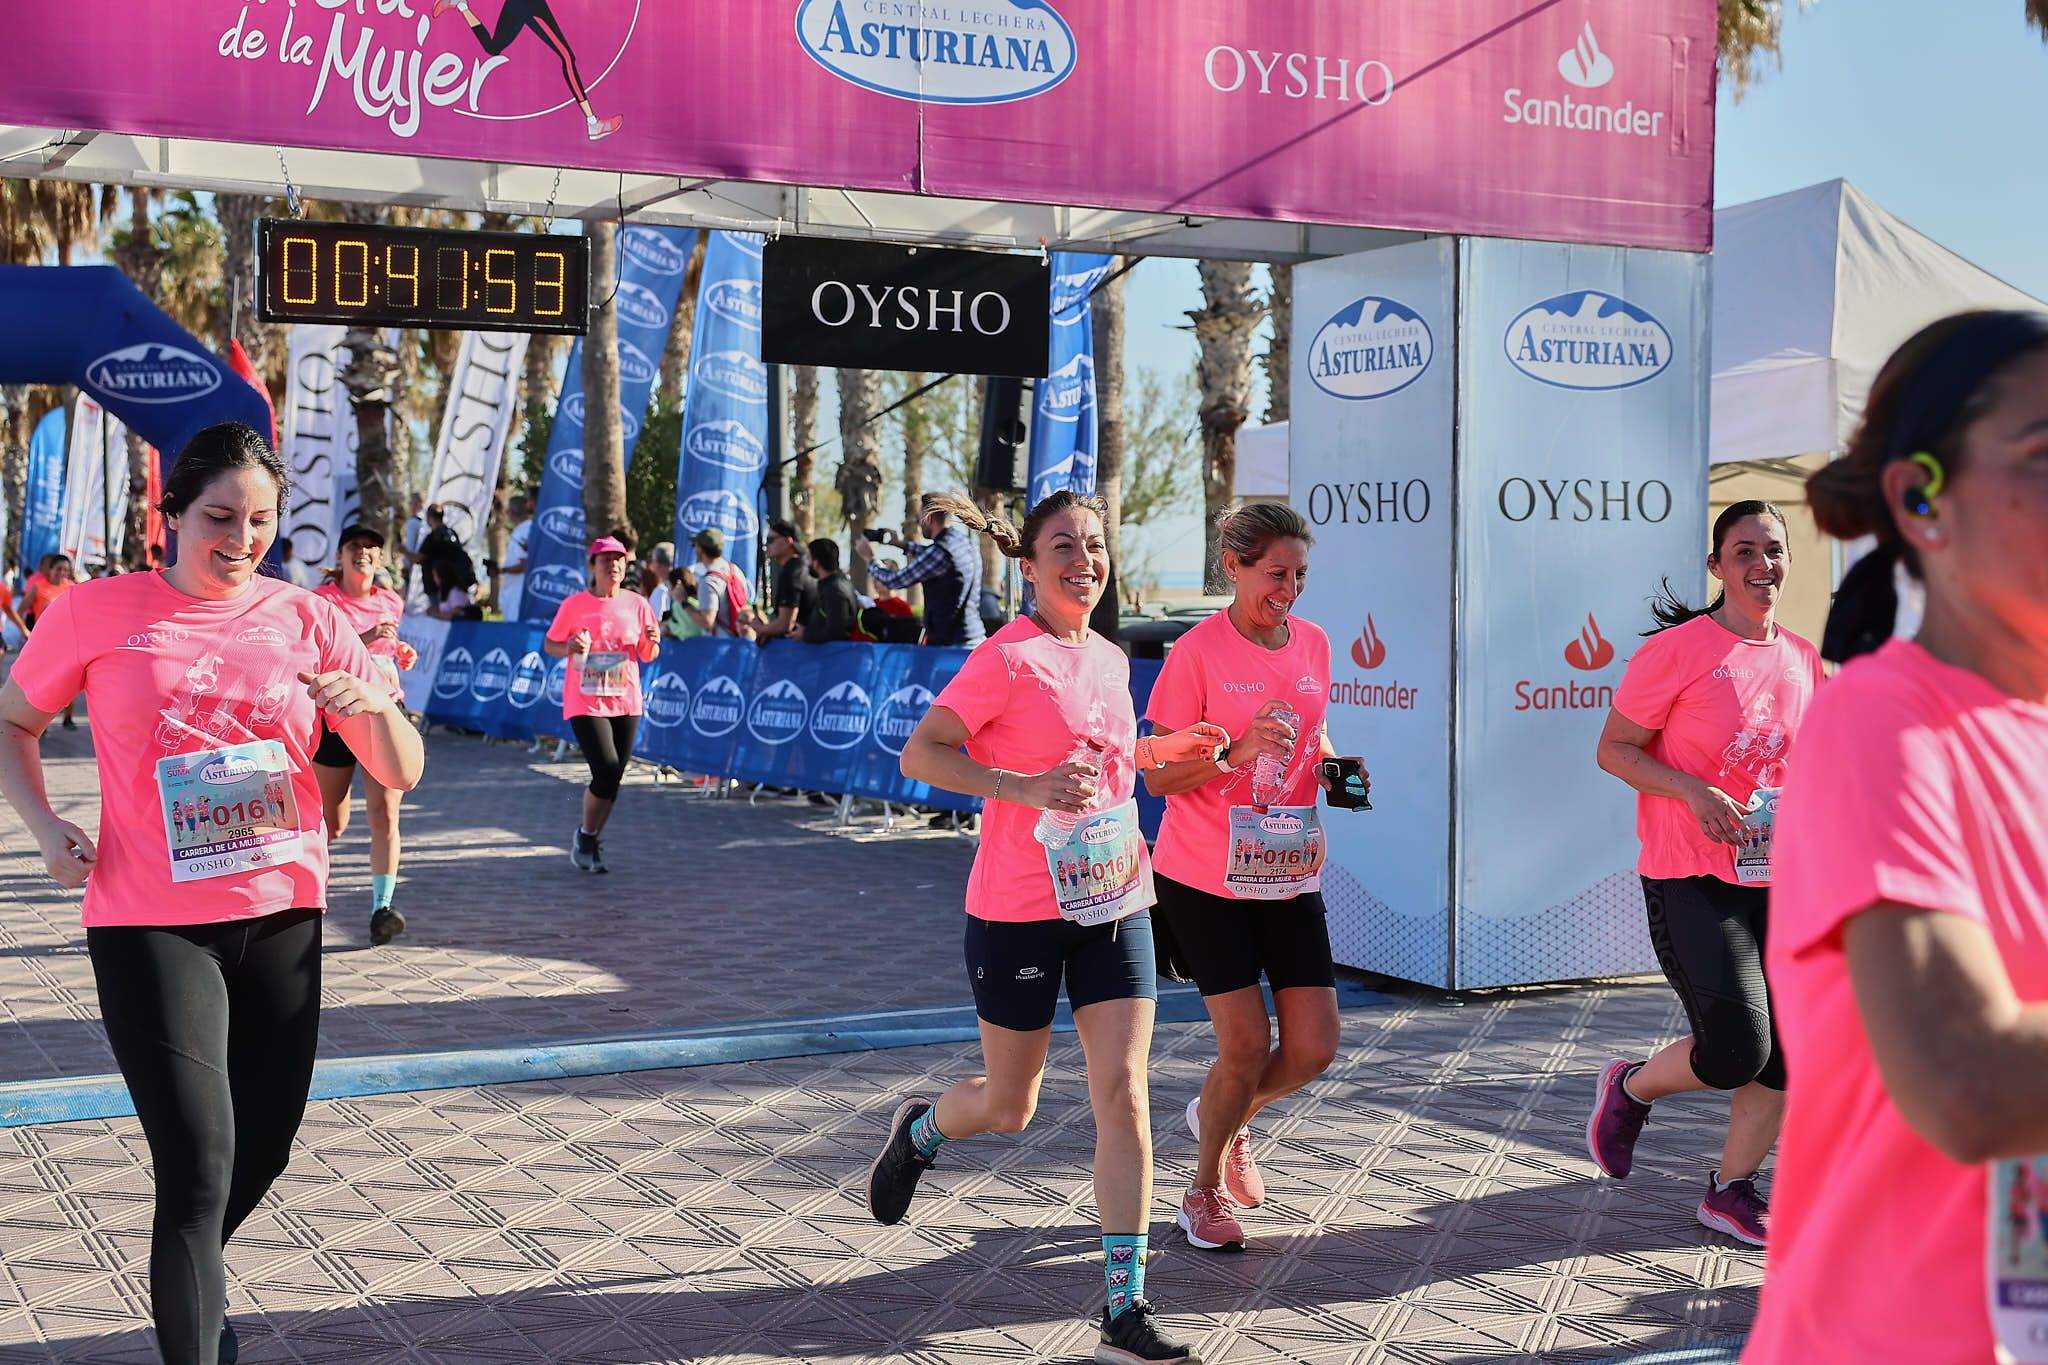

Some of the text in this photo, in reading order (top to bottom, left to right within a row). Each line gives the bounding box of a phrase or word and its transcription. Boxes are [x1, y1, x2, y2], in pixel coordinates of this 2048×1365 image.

[864, 0, 1047, 31] CENTRAL LECHERA
[819, 0, 1056, 74] ASTURIANA
[218, 5, 510, 138] de la Mujer
[1204, 45, 1394, 105] OYSHO
[1503, 87, 1664, 137] Santander
[283, 237, 565, 316] 00:41:53
[810, 279, 1012, 336] OYSHO
[1316, 341, 1423, 378] ASTURIANA
[1516, 324, 1660, 367] ASTURIANA
[98, 365, 214, 390] ASTURIANA
[1308, 478, 1431, 526] OYSHO
[1499, 477, 1672, 523] OYSHO
[127, 630, 189, 647] OYSHO
[1223, 682, 1265, 693] OYSHO
[1330, 677, 1418, 710] antander
[1514, 679, 1616, 711] Santan
[213, 799, 265, 826] 016
[179, 846, 214, 858] CARRERA
[215, 843, 226, 853] DE
[227, 841, 238, 850] LA
[239, 836, 266, 848] MUJER
[228, 826, 254, 839] 2965
[189, 857, 234, 873] OYSHO
[1091, 855, 1125, 881] 016
[1264, 849, 1301, 864] 016
[1746, 868, 1771, 877] OYSH
